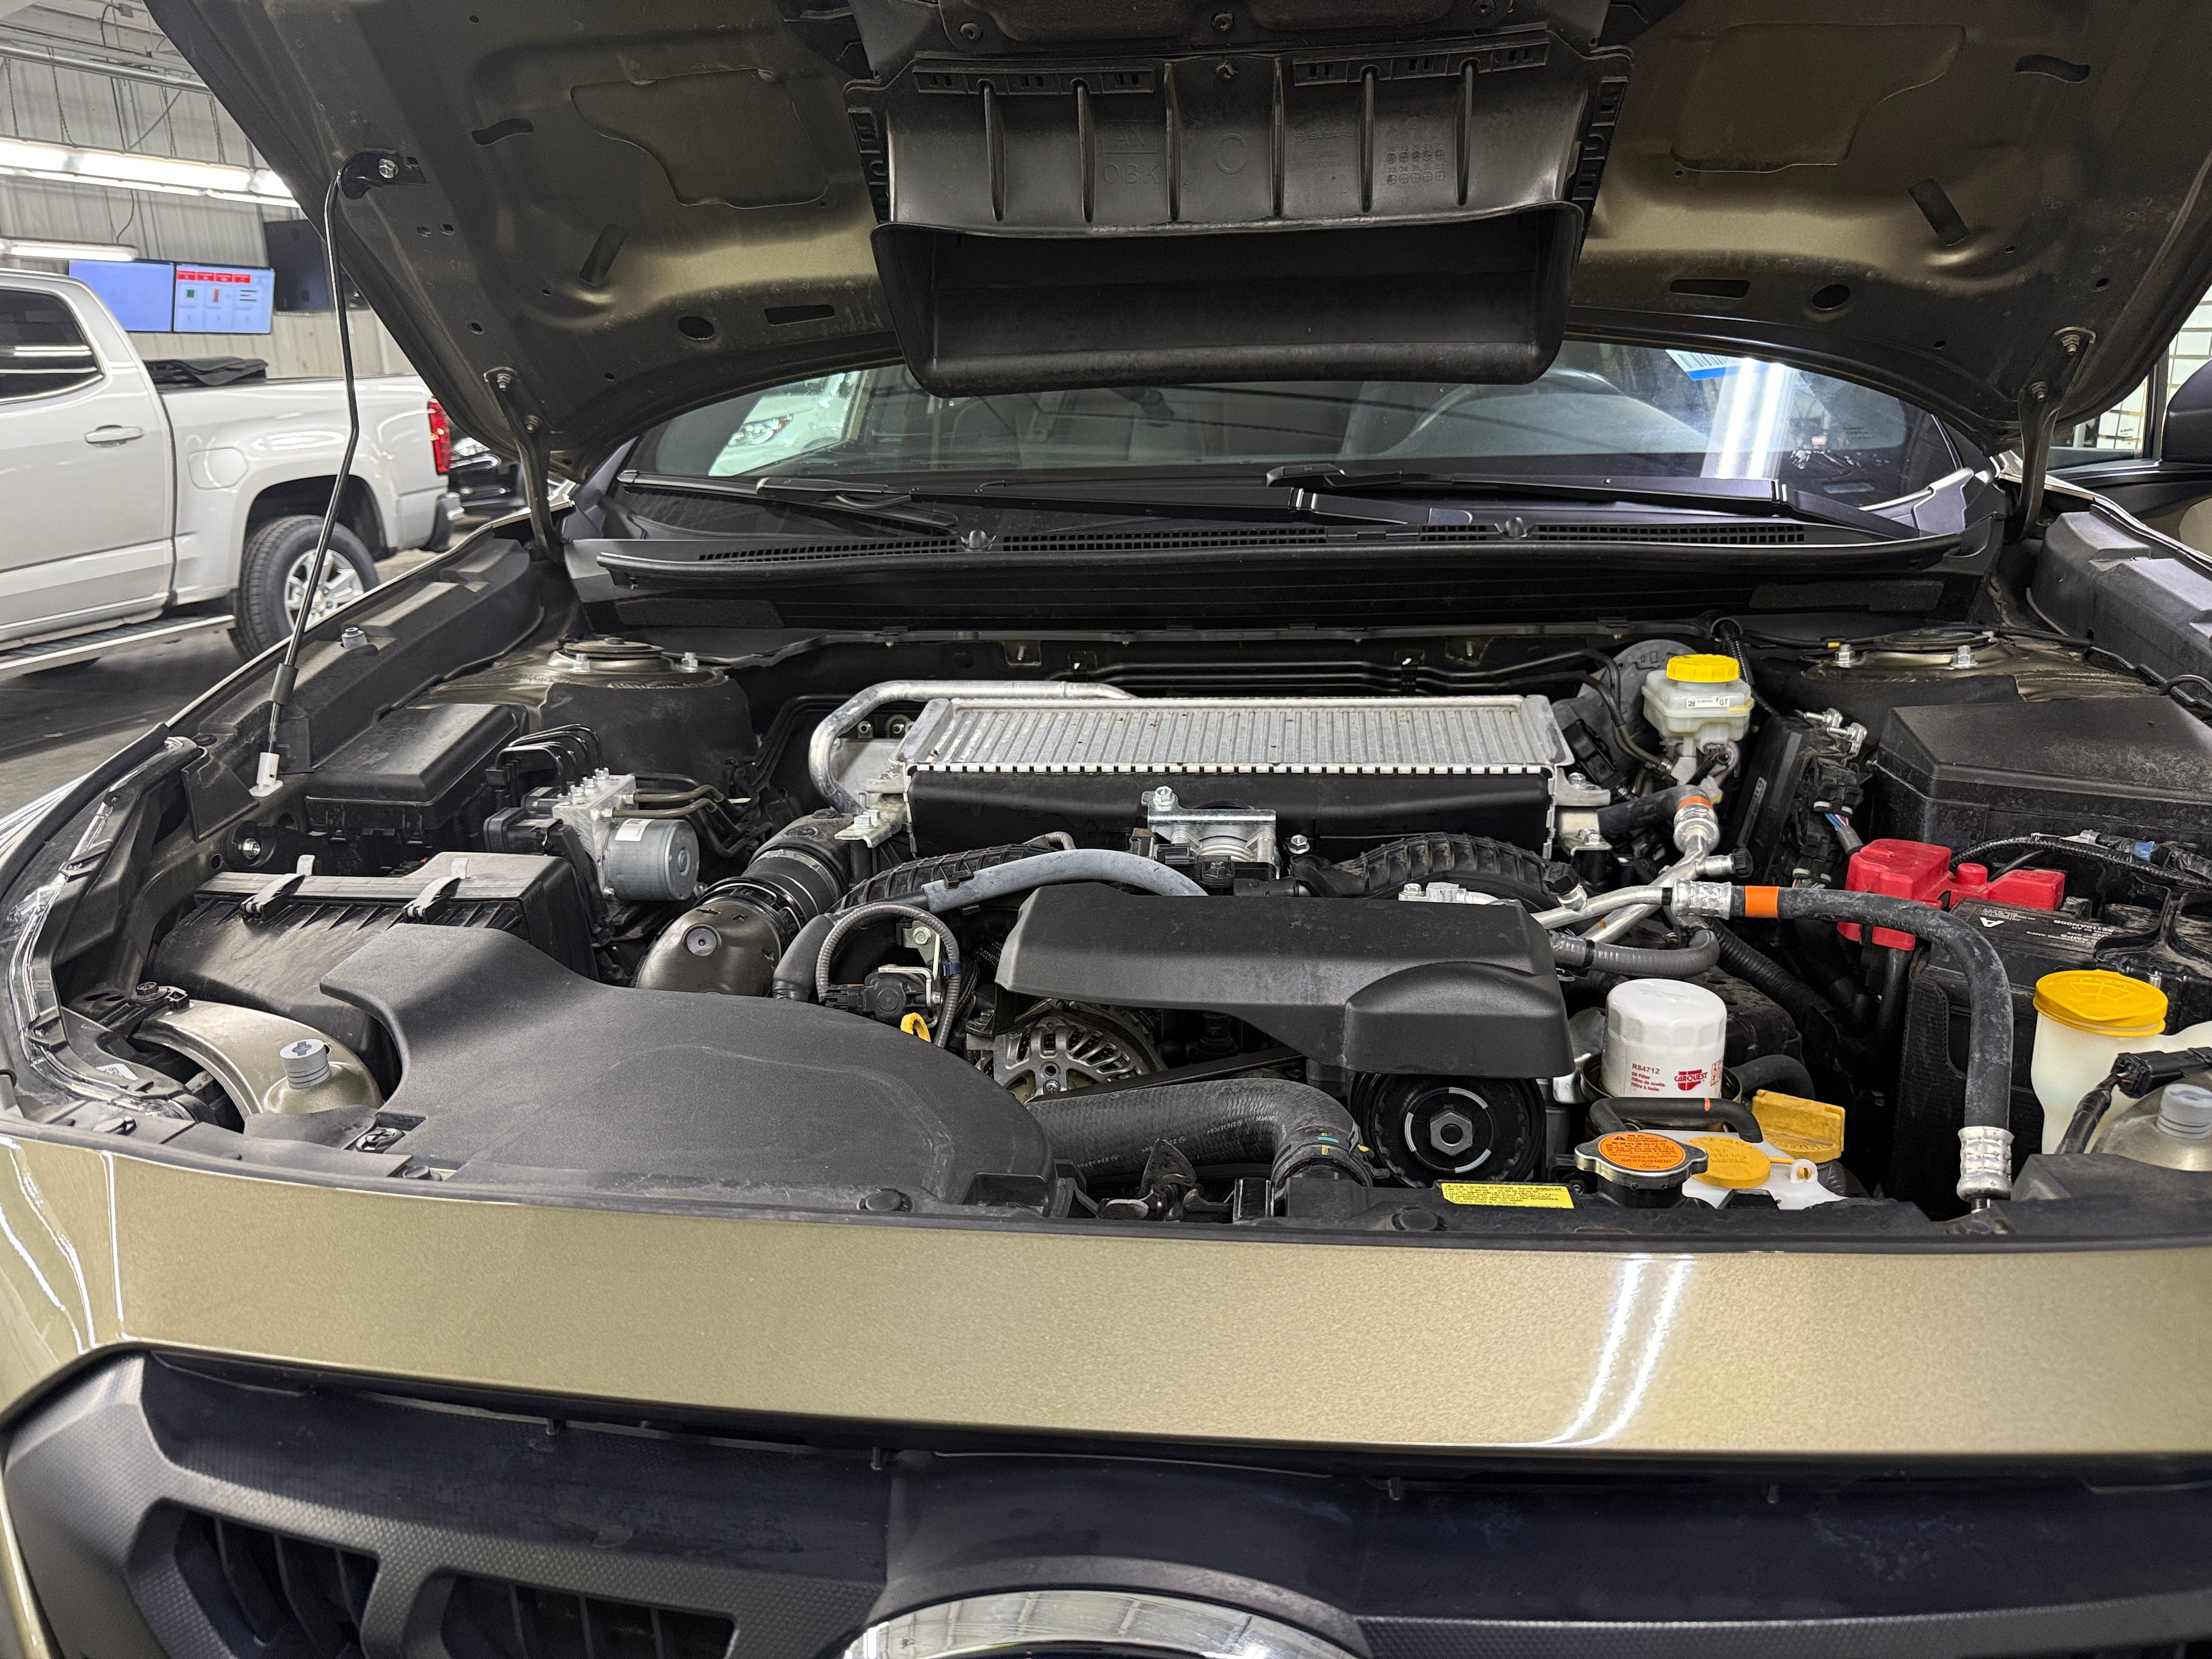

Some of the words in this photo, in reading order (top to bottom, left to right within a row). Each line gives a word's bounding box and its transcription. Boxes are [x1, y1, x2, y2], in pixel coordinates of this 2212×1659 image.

[1103, 163, 1161, 184] OBK
[1632, 1063, 1660, 1075] R84712
[1674, 1071, 1708, 1082] CARQUEST
